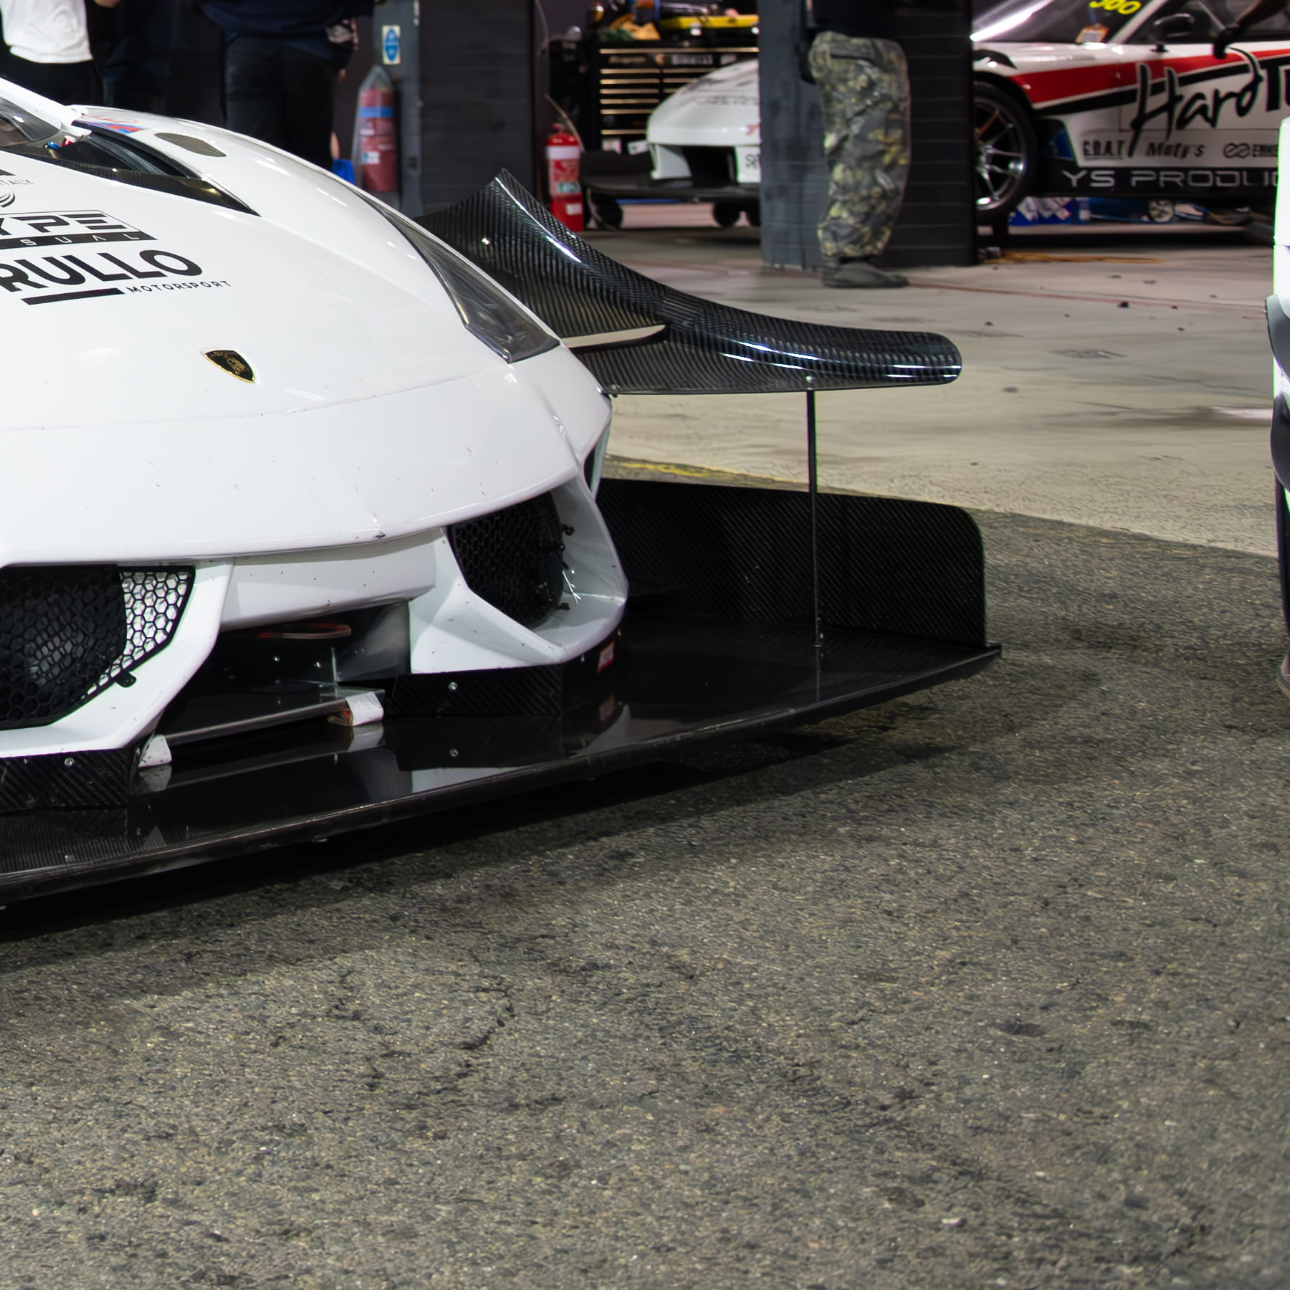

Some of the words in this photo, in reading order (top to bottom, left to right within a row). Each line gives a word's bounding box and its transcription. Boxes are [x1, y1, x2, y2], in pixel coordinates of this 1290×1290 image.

[1061, 169, 1115, 187] YS
[1131, 169, 1280, 187] PRODU
[125, 279, 232, 294] MOTORSPORT
